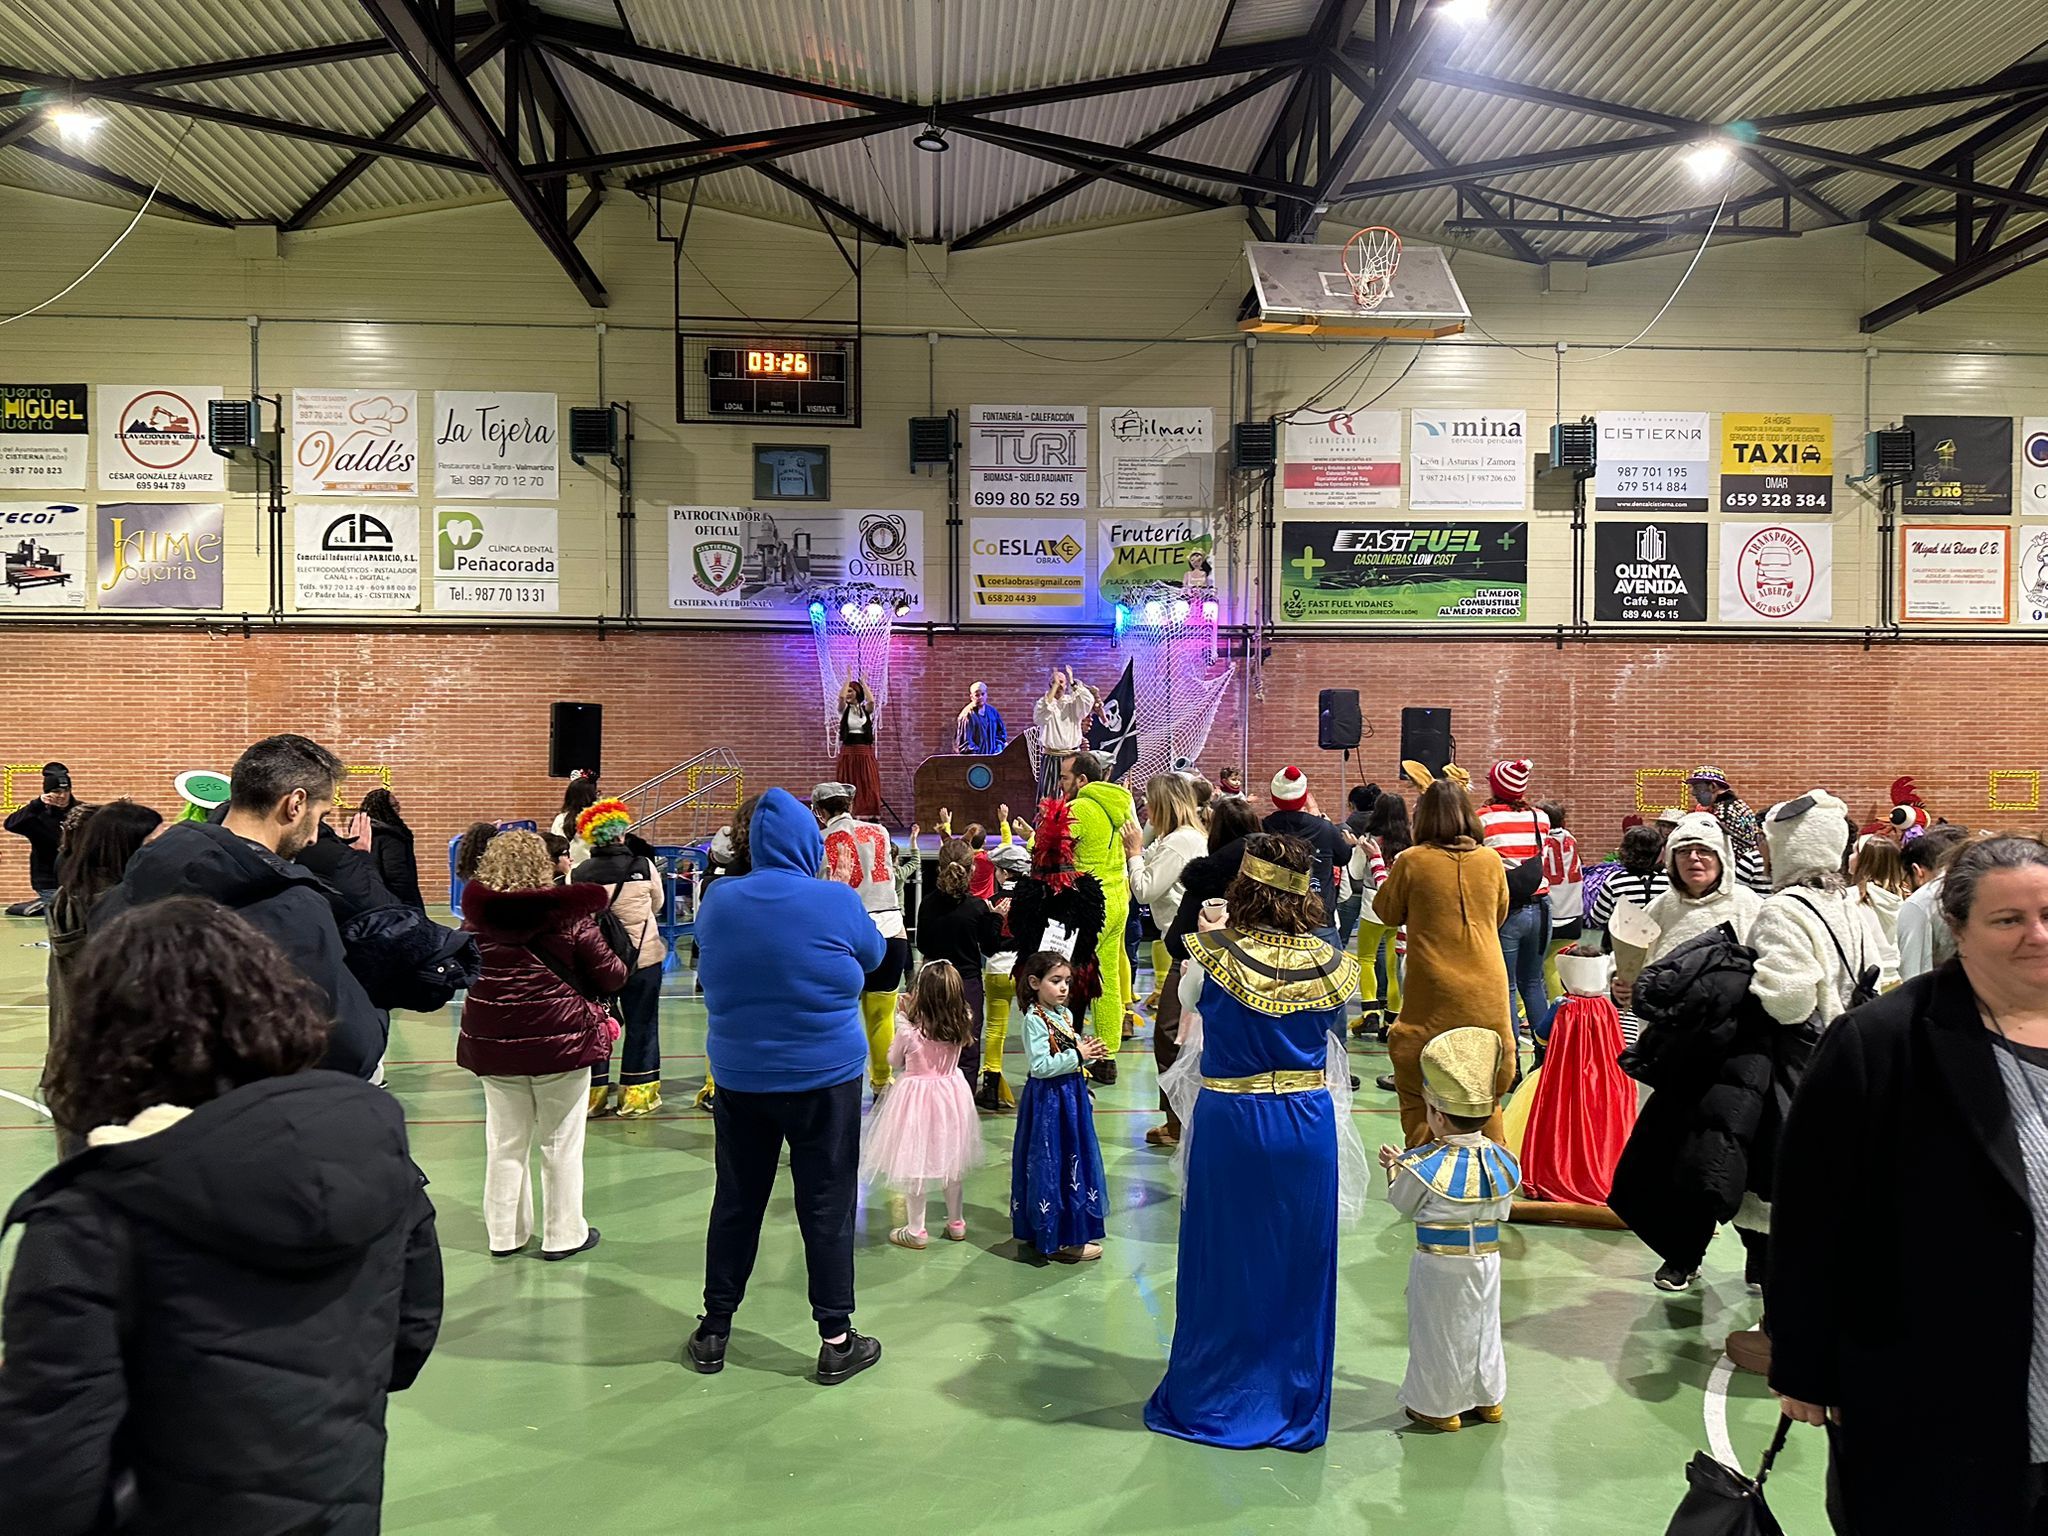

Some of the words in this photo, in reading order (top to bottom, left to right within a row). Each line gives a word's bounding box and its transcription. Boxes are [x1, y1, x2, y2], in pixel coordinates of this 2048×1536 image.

[748, 352, 808, 373] 03:26
[5, 398, 84, 420] MIGUEL
[806, 405, 837, 414] VISITANTE
[982, 411, 1023, 421] FONTANERÍA
[1030, 412, 1075, 422] CALEFACCIÓN
[437, 408, 473, 445] La
[475, 405, 556, 458] Tejera
[1119, 417, 1203, 437] Filmavi
[1452, 416, 1522, 437] mina
[981, 430, 1076, 466] TURI
[1733, 443, 1798, 463] TAXI
[298, 430, 415, 481] Valdés
[1420, 457, 1439, 466] León
[1447, 458, 1478, 466] Asturias
[1487, 458, 1516, 466] Zamora
[109, 471, 135, 480] CÉSAR
[136, 471, 177, 480] GONZÁLEZ
[179, 472, 213, 481] ÁLVAREZ
[1617, 466, 1638, 477] 987
[1642, 467, 1662, 477] 701
[1667, 467, 1688, 478] 195
[469, 475, 490, 485] 987
[494, 476, 508, 486] 70
[513, 476, 526, 486] 12
[530, 477, 544, 487] 70
[983, 473, 1013, 483] BIOMASA
[1019, 474, 1040, 483] SUELO
[1041, 474, 1073, 483] RADIANTE
[1765, 477, 1788, 489] OMAR
[136, 482, 152, 490] 695
[153, 482, 169, 490] 944
[171, 482, 186, 490] 789
[1617, 481, 1638, 491] 679
[1642, 482, 1662, 492] 514
[1667, 482, 1687, 492] 884
[1932, 486, 1962, 497] ORO
[974, 491, 1005, 506] 699
[1009, 491, 1030, 506] 80
[1034, 492, 1055, 507] 52
[1060, 492, 1080, 507] 59
[1726, 493, 1757, 507] 659
[1761, 494, 1791, 507] 328
[1795, 494, 1826, 508] 384
[673, 510, 761, 522] PATROCINADOR
[695, 525, 740, 536] OFICIAL
[1110, 522, 1192, 543] Frutería
[523, 545, 554, 554] DENTAL
[695, 543, 738, 553] CISTIERNA
[1748, 532, 1804, 556] TRANSPORTES
[1912, 541, 1940, 558] Miguel
[1940, 542, 1953, 554] del
[297, 553, 328, 561] Comercial
[363, 554, 402, 563] APARICIO,
[1118, 547, 1185, 565] MAITE
[1353, 554, 1412, 565] GASOLINERAS
[1413, 554, 1433, 565] LOW
[1433, 554, 1457, 565] COST
[457, 556, 555, 573] Peñacorada
[1615, 564, 1682, 579] QUINTA
[987, 577, 1081, 588] coeslaobras@gmail.com
[1613, 580, 1688, 595] AVENIDA
[475, 587, 496, 601] 987
[499, 588, 513, 601] 70
[516, 588, 529, 602] 13
[532, 589, 545, 602] 31
[1477, 590, 1489, 598] EL
[1490, 590, 1519, 598] MEJOR
[1758, 587, 1793, 598] ALBERTO
[674, 599, 718, 607] CISTIERNA
[987, 594, 1003, 603] 658
[1004, 594, 1014, 603] 20
[1015, 594, 1025, 603] 44
[1026, 595, 1037, 603] 39
[1460, 599, 1519, 607] COMBUSTIBLE
[1623, 596, 1649, 606] Café
[1658, 597, 1678, 606] Bar
[1439, 608, 1452, 616] AL
[1453, 608, 1483, 616] MEJOR
[1622, 611, 1639, 619] 689
[1641, 611, 1652, 619] 40
[1654, 611, 1666, 619] 45
[1667, 611, 1679, 619] 15
